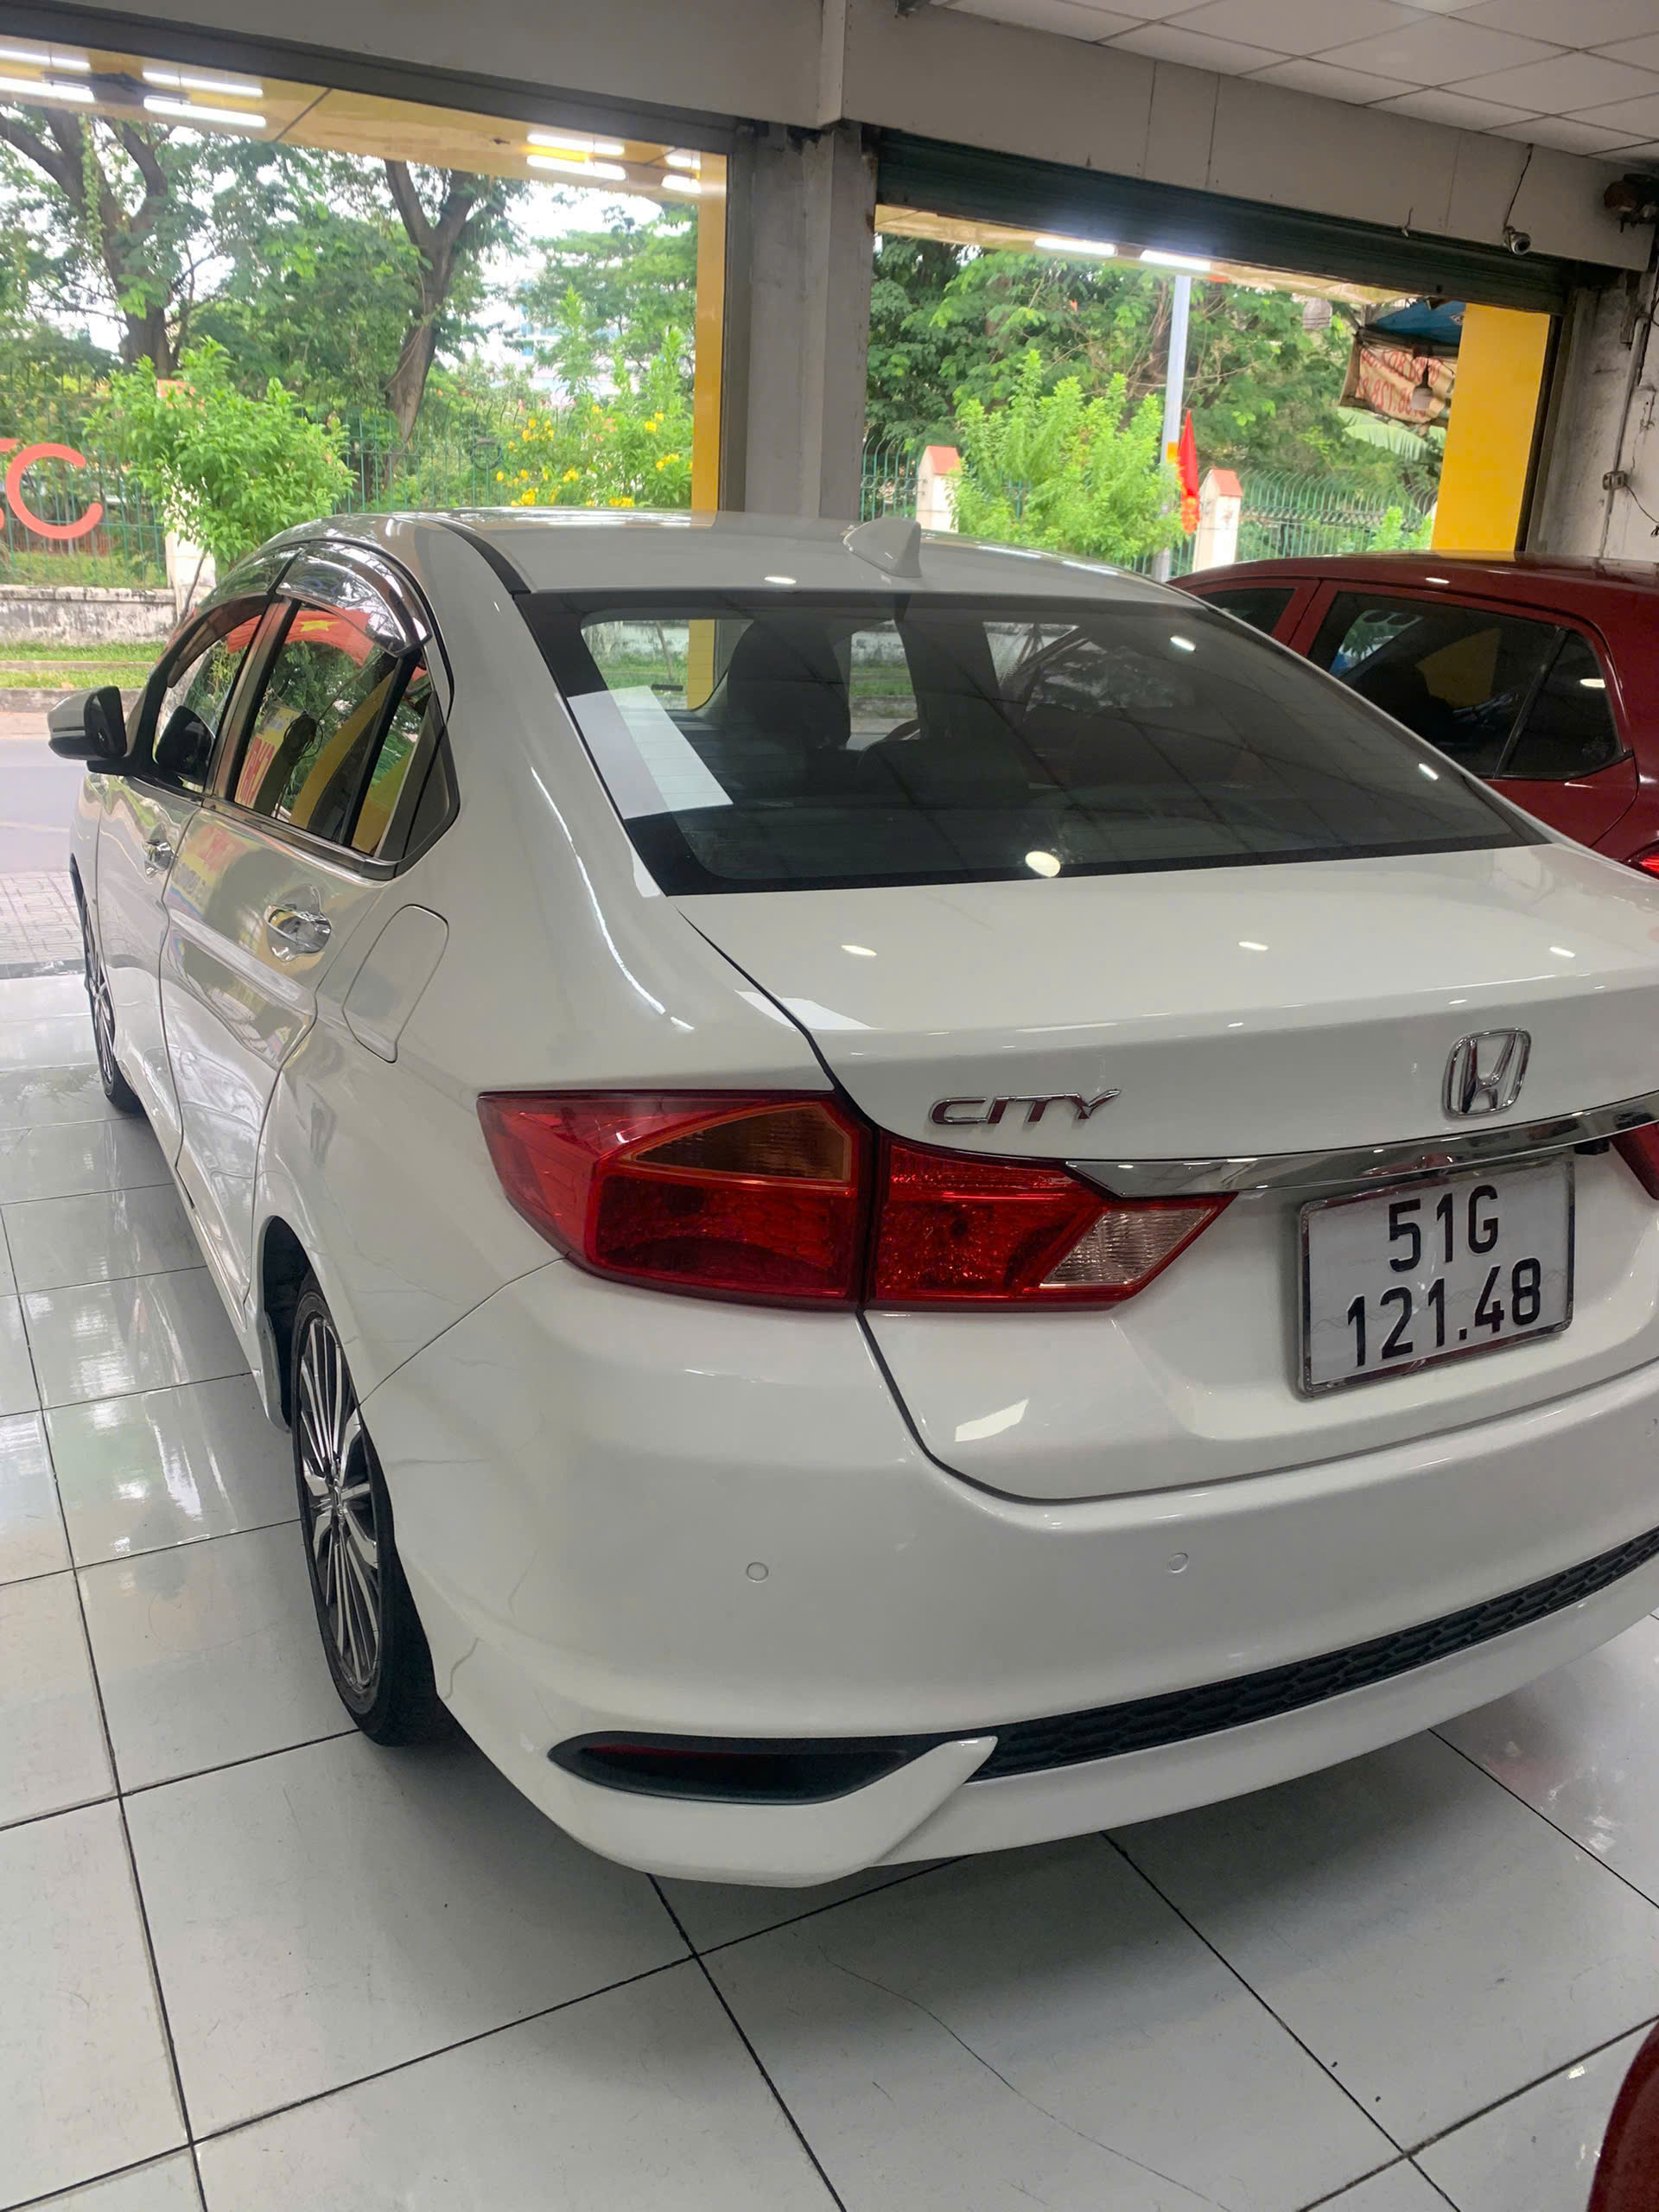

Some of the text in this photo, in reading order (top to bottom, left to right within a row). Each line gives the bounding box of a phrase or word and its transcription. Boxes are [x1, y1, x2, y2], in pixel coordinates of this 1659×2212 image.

[928, 1088, 1121, 1125] CITY
[1389, 1185, 1498, 1272] 51G
[1347, 1258, 1541, 1367] 121.48
